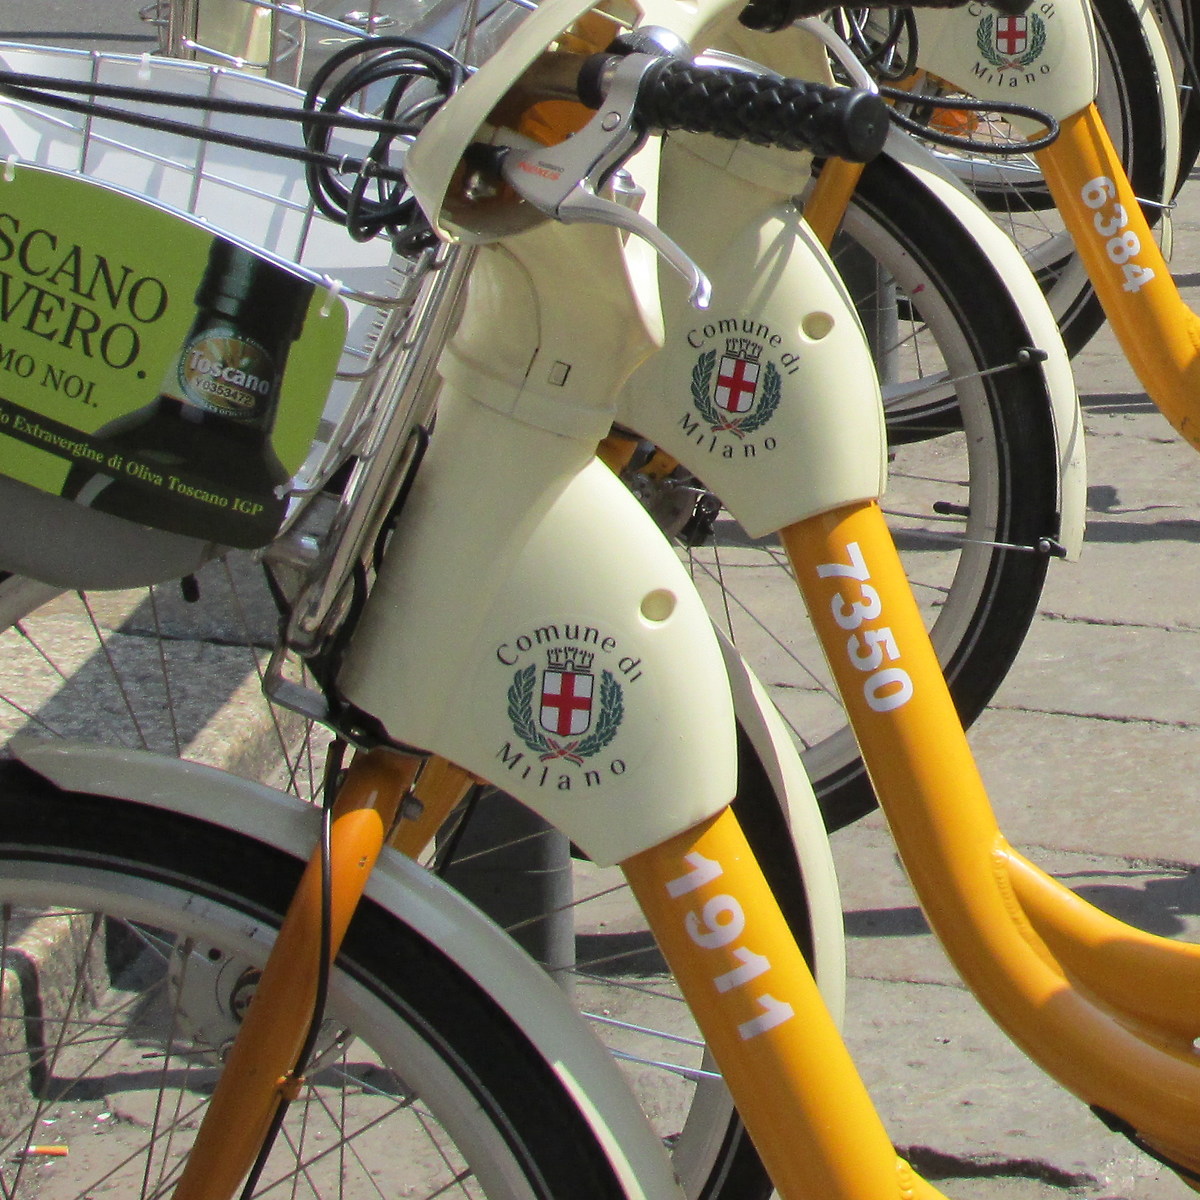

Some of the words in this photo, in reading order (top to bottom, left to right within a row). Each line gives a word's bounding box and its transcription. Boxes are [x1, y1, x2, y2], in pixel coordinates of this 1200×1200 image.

[1040, 3, 1055, 19] di
[971, 61, 1050, 88] Milano
[1081, 175, 1155, 293] 6384
[0, 270, 146, 379] VERO.
[687, 318, 782, 351] Comune
[781, 350, 800, 376] di
[40, 364, 98, 408] NOI.
[191, 350, 270, 395] Toscano
[678, 411, 777, 459] Milano
[12, 414, 104, 464] Extravergine
[107, 455, 121, 471] di
[126, 460, 164, 486] Oliva
[168, 475, 229, 508] Toscano
[233, 497, 264, 516] IGP
[496, 624, 616, 666] Comune
[618, 656, 642, 683] di
[815, 540, 914, 714] 7350
[495, 741, 626, 790] Milano
[665, 851, 795, 1042] 1911
